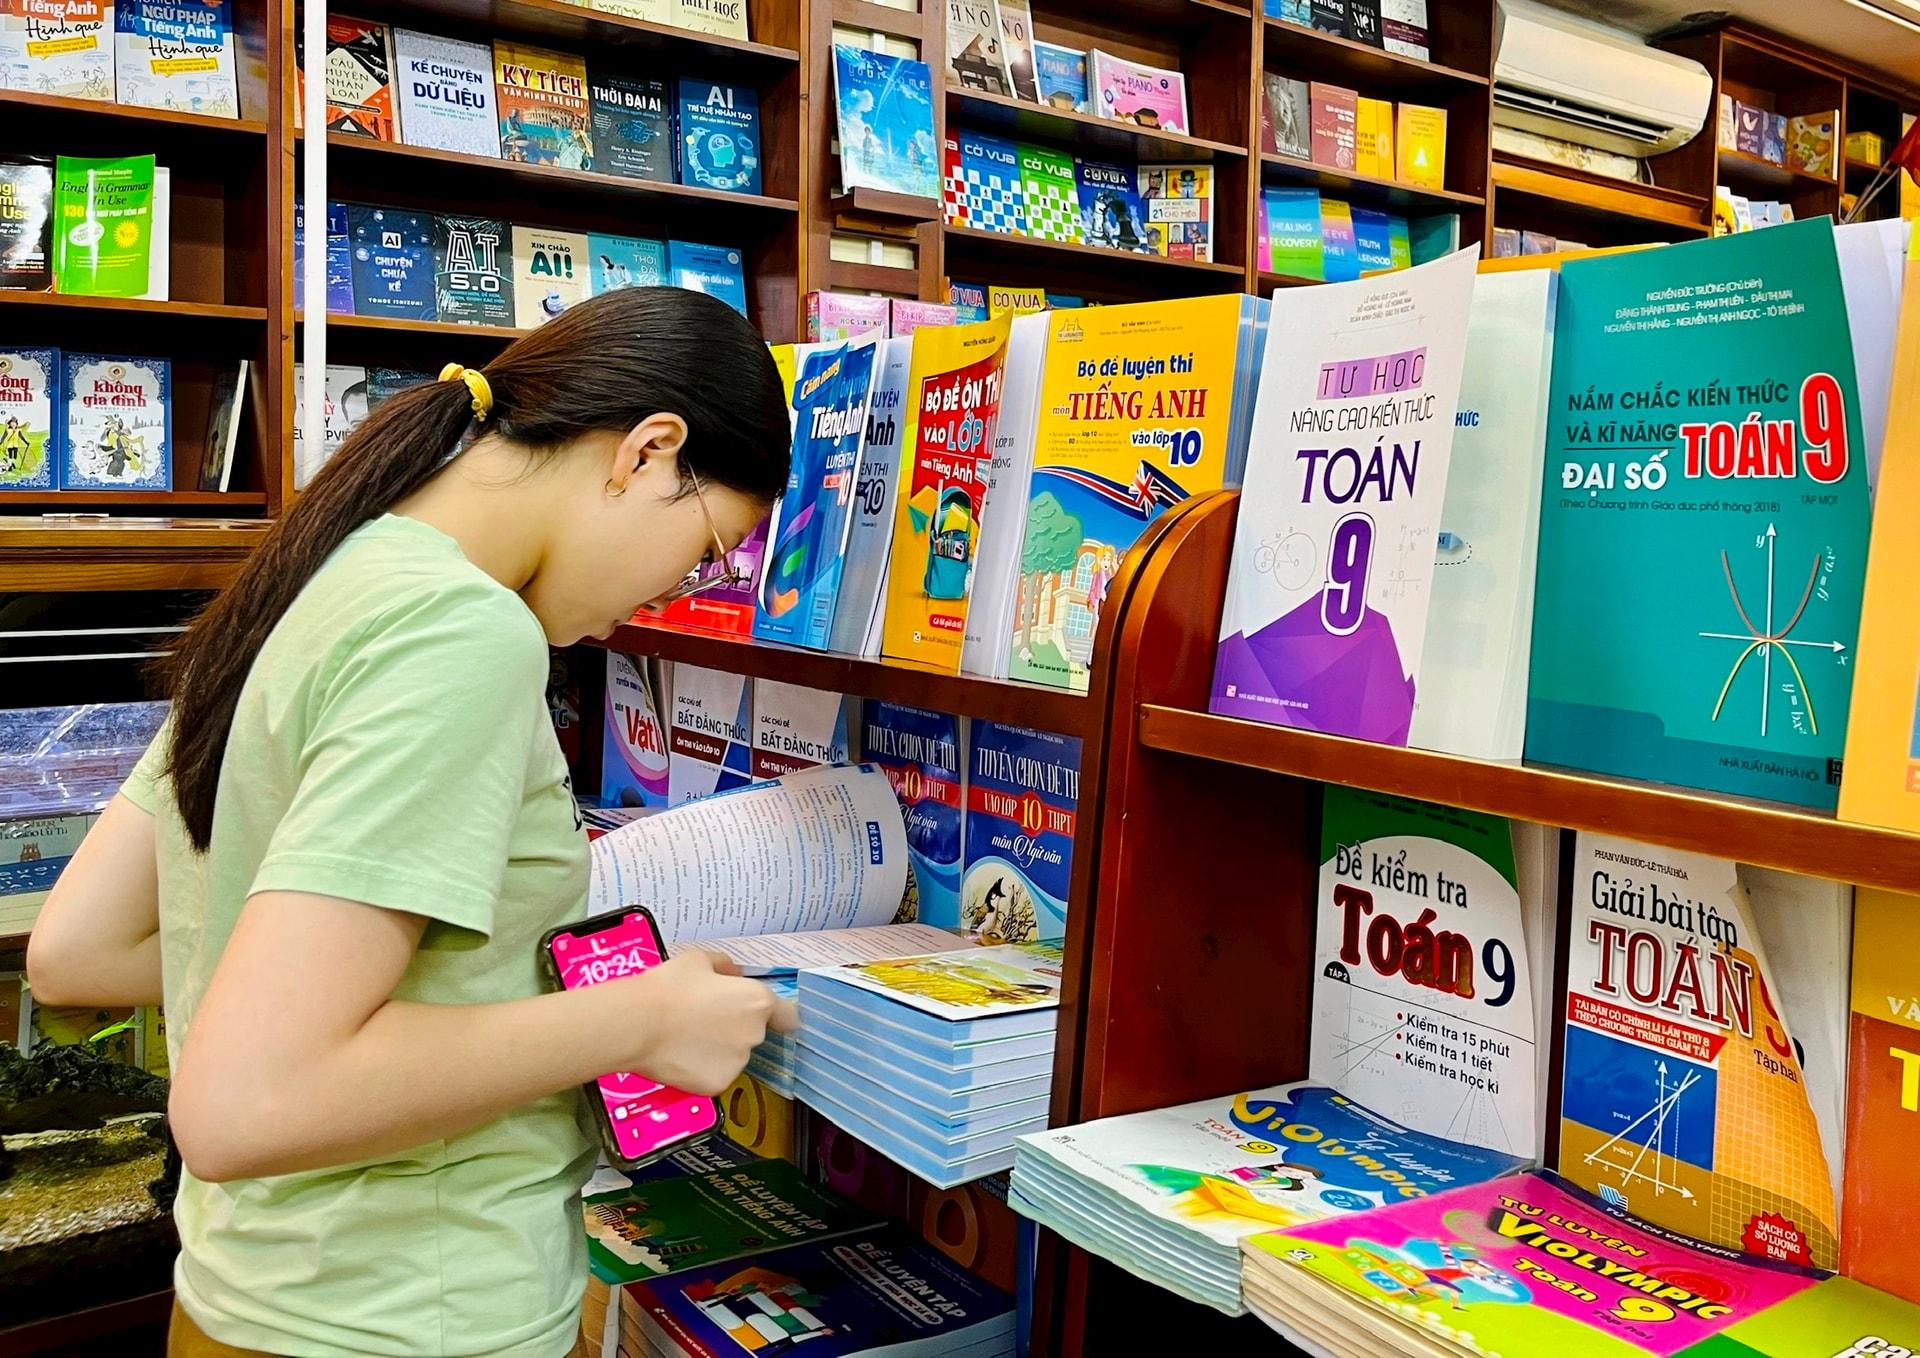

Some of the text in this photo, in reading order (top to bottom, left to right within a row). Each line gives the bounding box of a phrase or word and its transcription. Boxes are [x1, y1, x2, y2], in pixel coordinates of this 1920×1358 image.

[142, 2, 217, 25] NGỮ PHÁP
[142, 17, 217, 39] Tiếng Anh
[1043, 59, 1070, 77] PIANO
[1127, 76, 1154, 93] PIANO
[412, 80, 486, 112] DỮ LIỆU
[592, 85, 623, 106] THỜI
[624, 92, 647, 113] ĐẠI
[648, 97, 661, 112] AI
[687, 102, 700, 114] TRÍ
[705, 86, 735, 110] AI
[104, 182, 150, 193] Grammar
[383, 233, 400, 247] AI
[1271, 221, 1313, 233] HEALING
[1357, 238, 1381, 250] TRUTH
[374, 254, 414, 270] CHUYỆN
[446, 230, 502, 276] AI
[530, 240, 571, 254] XIN CHÀO
[529, 250, 574, 279] AI!
[449, 273, 501, 293] 5.0
[1012, 292, 1041, 310] VUA
[1078, 352, 1194, 382] Bộ đề luyện thi
[1321, 353, 1426, 400] TỰ HỌC
[83, 393, 108, 409] gia
[110, 392, 148, 408] đình
[94, 379, 144, 396] không
[1068, 381, 1144, 421] TIẾNG
[1148, 388, 1208, 420] ANH
[1568, 377, 1790, 412] NẮM CHẮC KIẾN THỨC
[811, 400, 864, 448] Tiếng Anh
[923, 408, 984, 454] VÀO LỚP
[1289, 394, 1437, 434] NÂNG CAO KIẾN THỨC
[1566, 419, 1593, 444] VÀ
[1619, 417, 1678, 443] NĂNG
[1681, 371, 1849, 484] TOÁN 9
[1132, 430, 1150, 446] vào
[1151, 429, 1170, 449] lớp
[1169, 430, 1202, 467] 10
[873, 462, 889, 476] THI
[1295, 435, 1422, 505] TOÁN
[1561, 448, 1670, 498] ĐẠI SỐ
[864, 478, 886, 515] 10
[1559, 498, 1586, 511] (Theo
[1587, 498, 1630, 513] Chương
[1631, 498, 1650, 512] trình
[1651, 498, 1676, 512] Giáo
[1677, 499, 1698, 514] dục
[1721, 499, 1752, 514] thông
[1753, 500, 1781, 514] 2018)
[1755, 534, 1766, 548] y
[1321, 512, 1376, 636] 9
[1837, 654, 1849, 666] x
[625, 705, 654, 753] Vật
[678, 708, 747, 742] BẤT ĐẲNG THỨC
[761, 729, 845, 763] BẤT ĐẲNG THỨC
[868, 722, 956, 772] TUYỂN CHỌN ĐỀ THI
[1719, 755, 1740, 770] NHÀ
[1740, 757, 1765, 773] XUẤT
[1765, 761, 1785, 776] BẢN
[1786, 764, 1800, 778] HÀ
[983, 791, 1074, 834] VÀO LỚP 10 THPT
[991, 834, 1063, 869] môn Ngữ văn
[1335, 840, 1469, 909] Đề kiểm tra
[1591, 869, 1737, 956] Giải bài tập
[1332, 882, 1516, 1008] Toán 9
[578, 948, 645, 986] 10:24
[1328, 966, 1349, 982] TẬP 2
[1587, 918, 1754, 1038] TOÁN
[1406, 1008, 1511, 1059] Kiểm tra 15 phút
[1574, 1008, 1711, 1059] THEO CHƯƠNG TRÌNH GIẢM TẢI
[1405, 1029, 1493, 1073] Kiểm tra 1 tiết
[1753, 1048, 1779, 1076] Tập
[1405, 1050, 1438, 1075] Kiểm
[1439, 1062, 1457, 1081] tra
[1458, 1067, 1485, 1091] học
[1203, 1116, 1247, 1142] TOÁN
[1236, 1140, 1279, 1156] 9
[703, 1173, 807, 1238] MÔN TIẾNG ANH
[750, 1185, 800, 1220] LUYỆN
[797, 1213, 829, 1232] TẬP
[1498, 1194, 1649, 1260] TỰ LUYỆN
[1757, 1220, 1798, 1242] SÁCH CÓ
[1496, 1211, 1735, 1321] VIOLYMPIC
[1513, 1256, 1678, 1323] Toán 9
